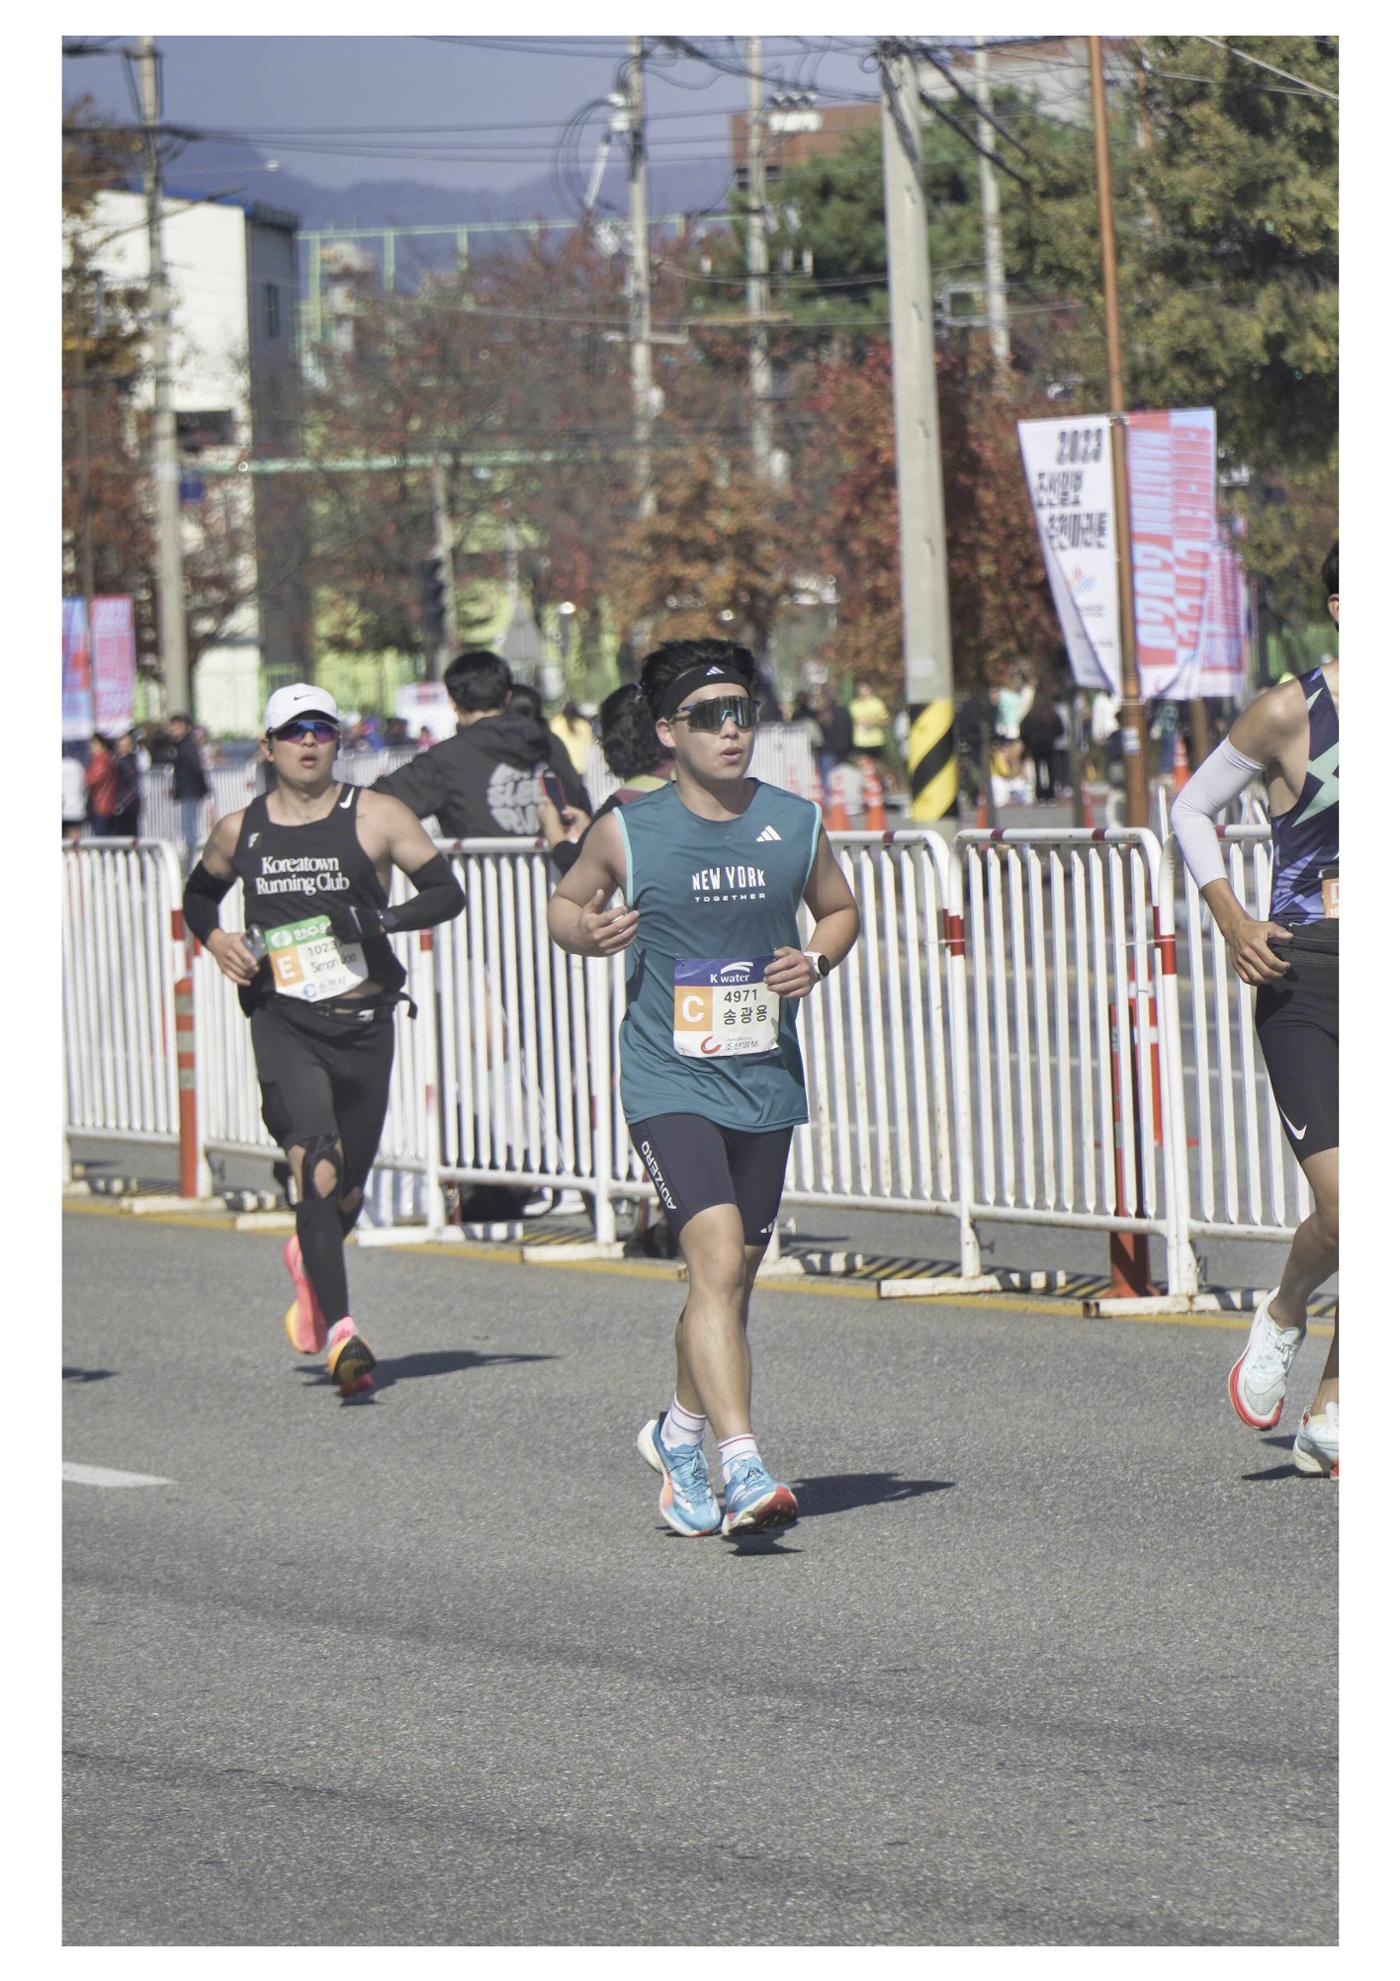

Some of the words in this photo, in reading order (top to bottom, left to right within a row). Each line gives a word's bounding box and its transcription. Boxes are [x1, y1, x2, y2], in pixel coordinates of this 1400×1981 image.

[1057, 428, 1103, 465] 2023
[261, 856, 340, 875] Koreatown
[255, 874, 317, 896] Running
[316, 871, 350, 891] Club
[692, 867, 720, 891] NEW
[725, 865, 766, 889] YORK
[694, 892, 766, 903] TOGETHER
[277, 956, 297, 980] E
[710, 974, 719, 984] K
[721, 973, 751, 983] water
[724, 988, 758, 1003] 4971
[682, 995, 705, 1023] C
[641, 1140, 677, 1210] ADIZERO
